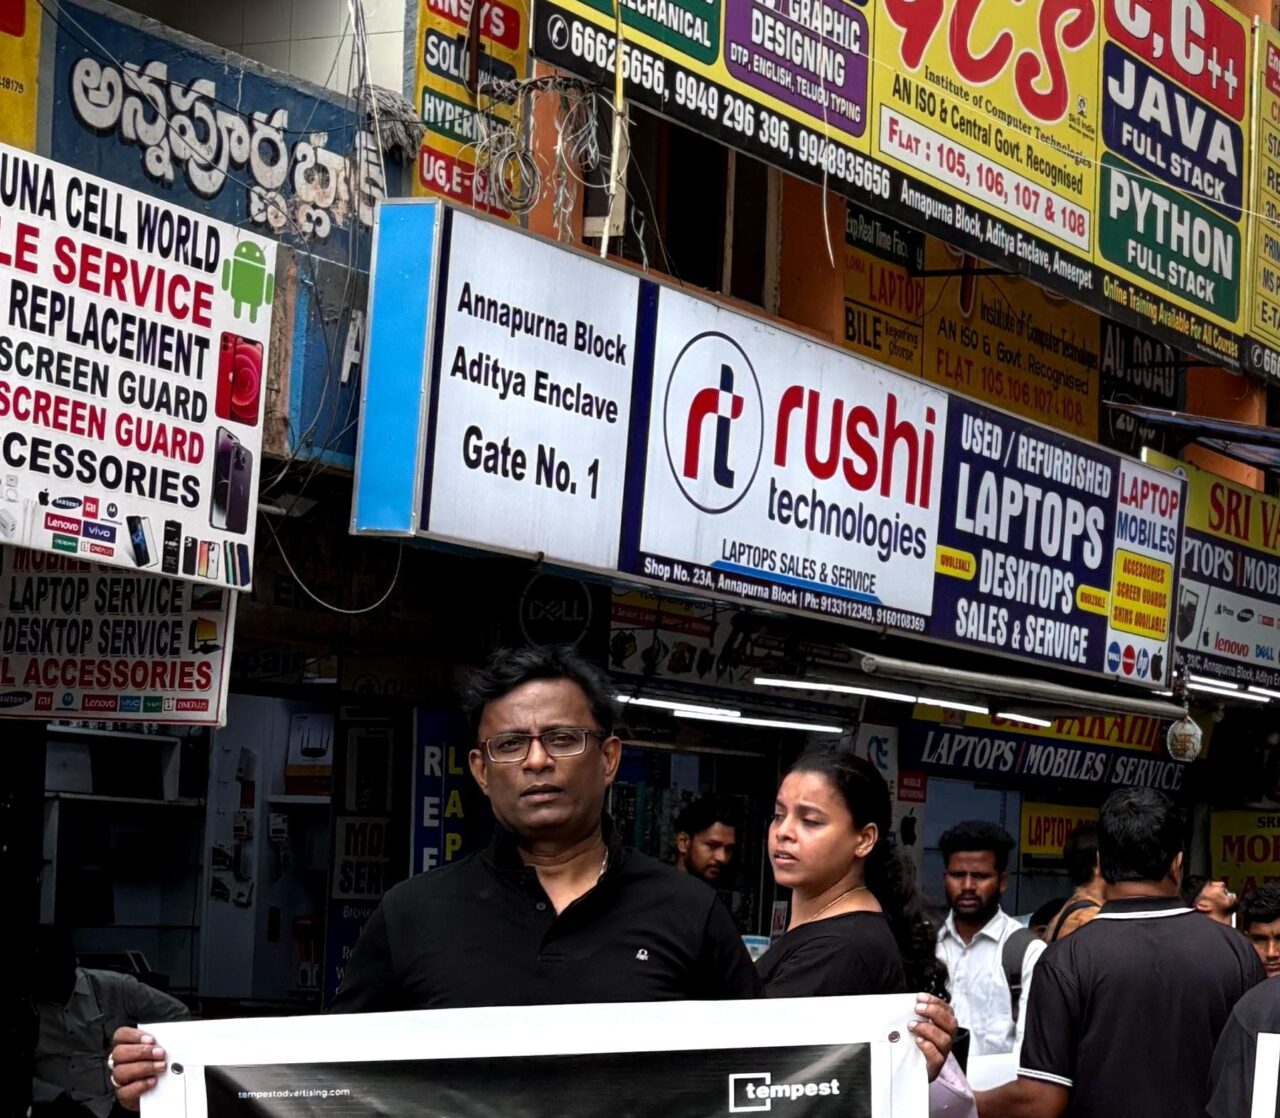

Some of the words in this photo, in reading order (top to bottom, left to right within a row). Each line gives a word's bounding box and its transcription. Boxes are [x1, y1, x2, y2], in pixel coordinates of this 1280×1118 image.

[924, 65, 970, 102] Institute
[974, 94, 983, 109] of
[984, 99, 1033, 137] Computer
[1107, 59, 1238, 177] JAVA
[1121, 121, 1164, 171] FULL
[1168, 157, 1227, 205] STACK
[65, 176, 128, 244] CELL
[137, 201, 221, 274] WORLD
[901, 179, 955, 225] Annapurna
[955, 204, 985, 242] Block,
[985, 218, 1016, 254] Aditya
[1016, 235, 1052, 273] Enclave,
[1108, 168, 1234, 281] PYTHON
[53, 235, 214, 329] SERVICE
[1127, 237, 1165, 279] FULL
[1167, 260, 1216, 305] STACK
[8, 279, 211, 380] REPLACEMENT
[457, 281, 568, 347] Annapurna
[574, 319, 627, 366] Block
[118, 371, 208, 424] GUARD
[450, 345, 526, 400] Aditya
[533, 369, 619, 424] Enclave
[115, 412, 205, 464] GUARD
[462, 425, 527, 482] Gate
[535, 443, 578, 495] No.
[587, 458, 600, 500] 1
[771, 383, 937, 510] rushi
[962, 413, 1003, 459] USED
[1017, 433, 1113, 499] REFURBISHED
[767, 476, 928, 564] technologies
[955, 463, 1104, 571] LAPTOPS
[1116, 509, 1177, 556] MOBILES
[1119, 471, 1179, 521] LAPTOP
[1208, 482, 1252, 540] SRI
[644, 557, 671, 582] Shop
[672, 562, 690, 584] No.
[693, 565, 715, 590] 23A,
[717, 573, 770, 600] Annapurna
[771, 583, 798, 606] Block
[979, 549, 1075, 615] DESKTOPS
[956, 597, 1009, 648] SALES
[1012, 621, 1021, 645] &
[1024, 614, 1089, 664] SERVICE
[1214, 634, 1249, 658] lenovo
[23, 660, 212, 691] ACCESSORIES
[745, 1078, 840, 1100] tempest
